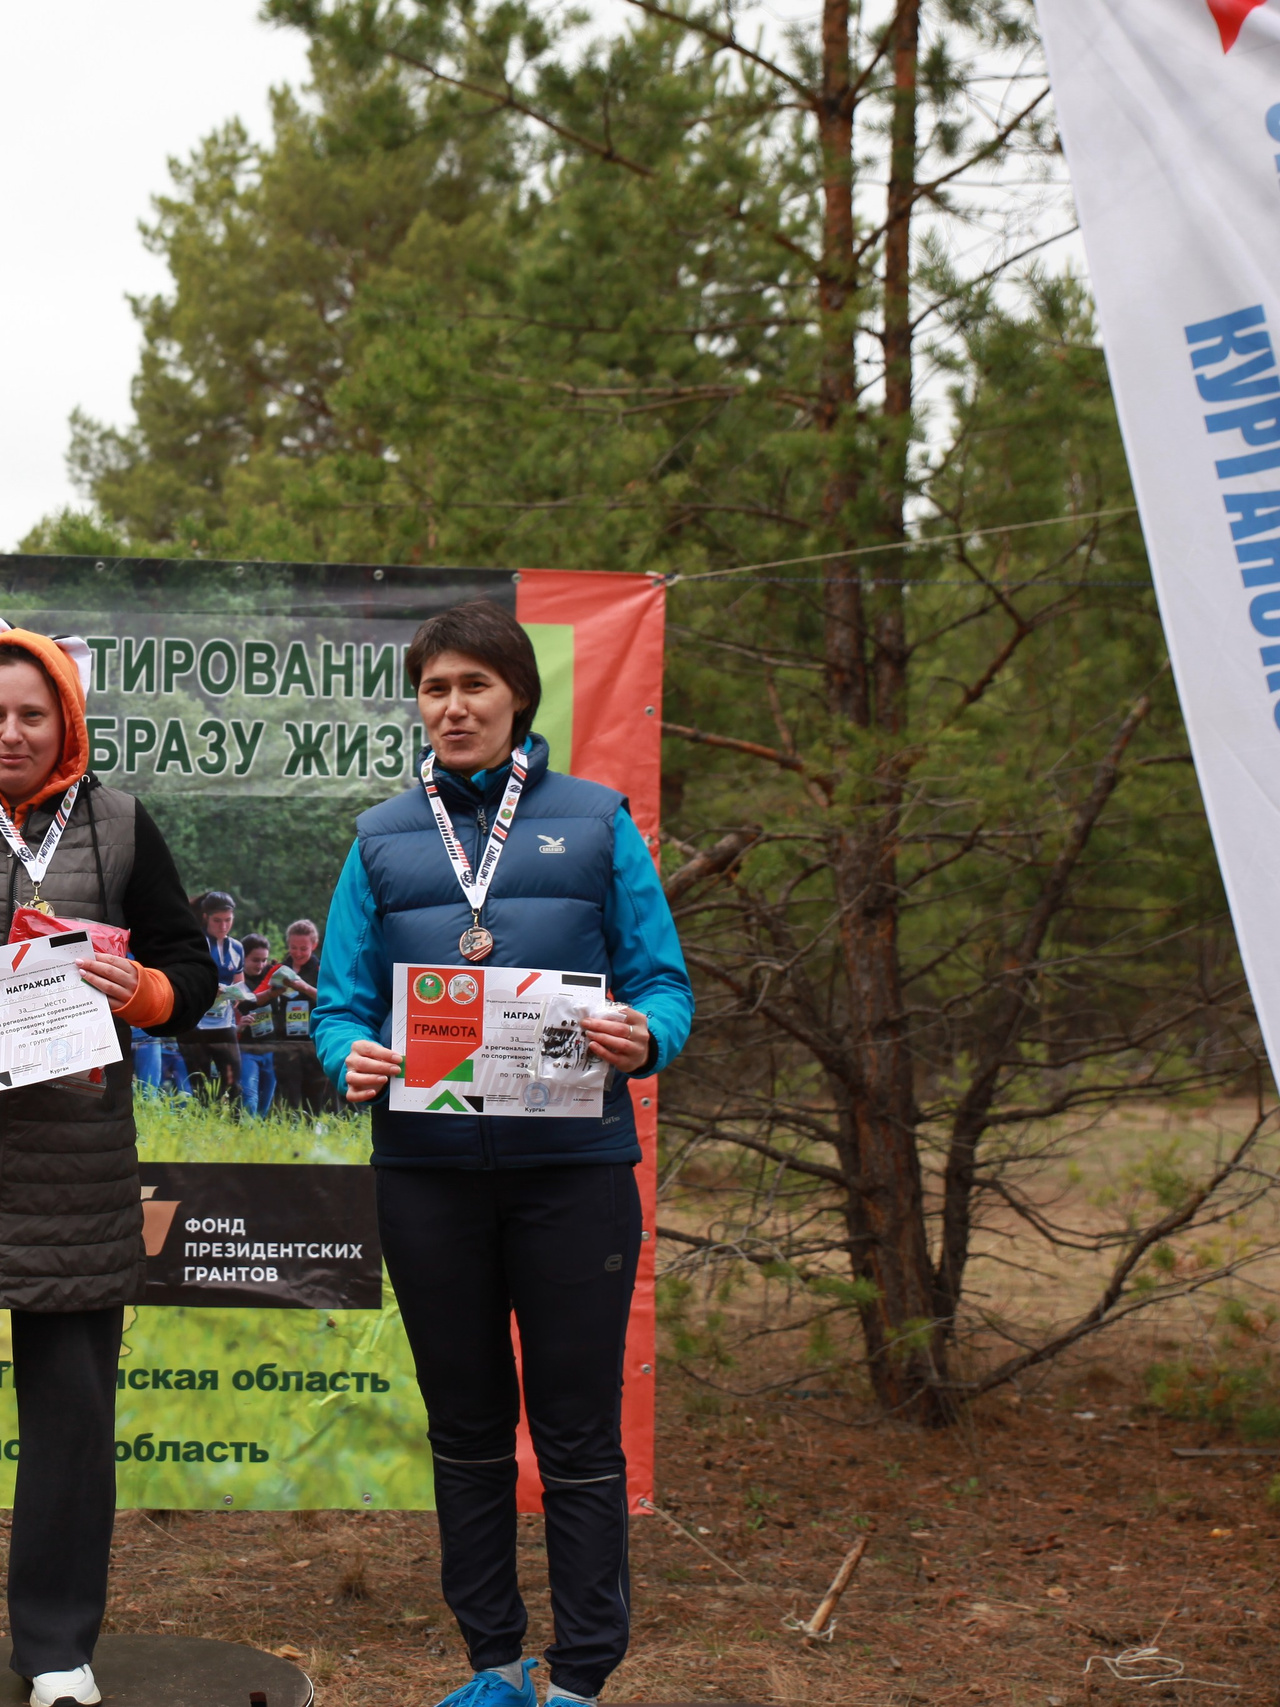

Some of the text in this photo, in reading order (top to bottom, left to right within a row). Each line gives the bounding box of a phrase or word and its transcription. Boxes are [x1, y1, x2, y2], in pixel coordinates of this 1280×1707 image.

[87, 717, 264, 776] БРАЗУ
[285, 722, 423, 778] ЖИЗ
[6, 975, 66, 994] НАГРАЖДАЕТ
[44, 998, 66, 1008] место
[2, 1013, 46, 1028] региональных
[47, 1001, 93, 1017] соревнованиях
[503, 1011, 540, 1019] НАГРАЖ
[5, 1022, 45, 1035] спортивному
[414, 1024, 477, 1037] ГРАМОТА
[50, 1066, 69, 1074] Курган
[185, 1218, 245, 1237] ФОНД
[184, 1242, 362, 1260] ПРЕЗИДЕНТСКИХ
[184, 1265, 278, 1283] ГРАНТОВ
[232, 1362, 390, 1393] область
[115, 1432, 269, 1463] область
